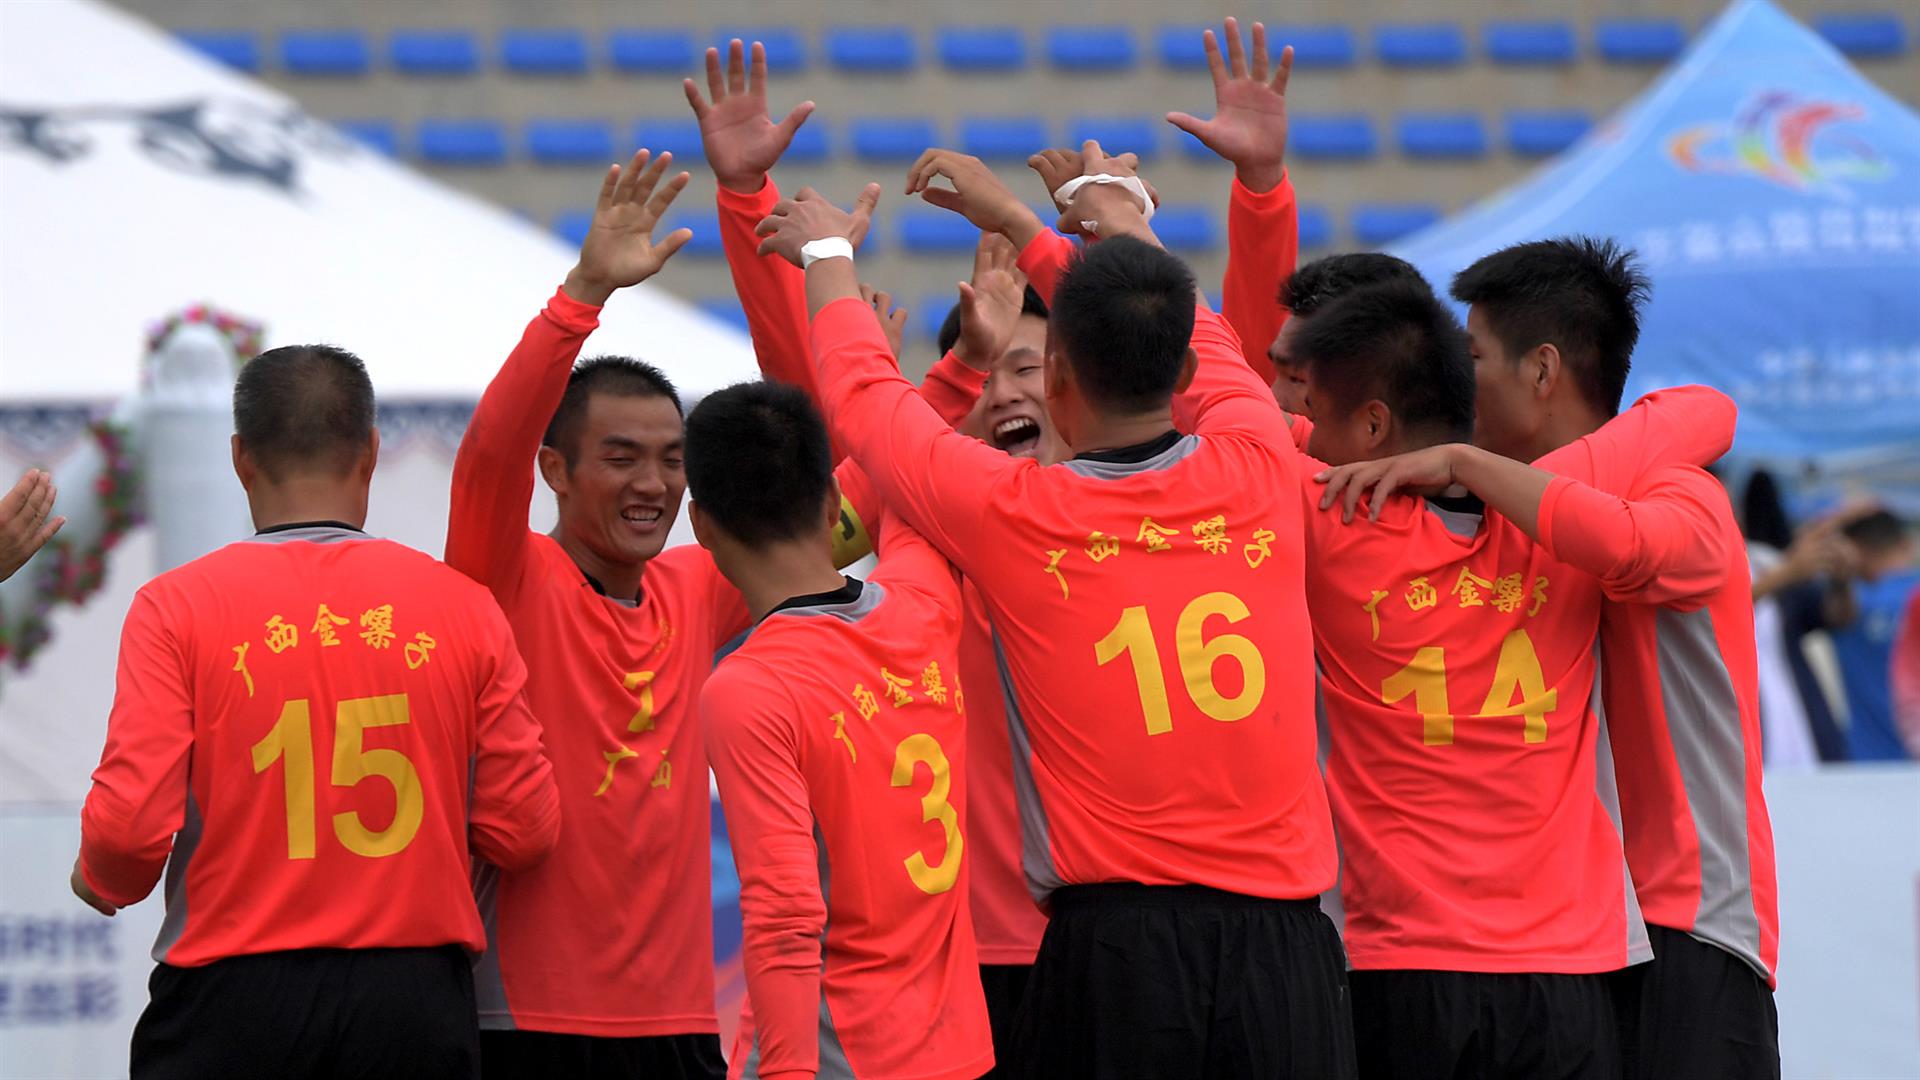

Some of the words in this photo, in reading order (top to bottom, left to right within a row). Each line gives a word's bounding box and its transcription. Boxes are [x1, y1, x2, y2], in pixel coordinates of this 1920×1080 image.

[1094, 591, 1266, 736] 16
[1380, 628, 1558, 746] 14
[249, 692, 424, 860] 15
[890, 733, 964, 895] 3
